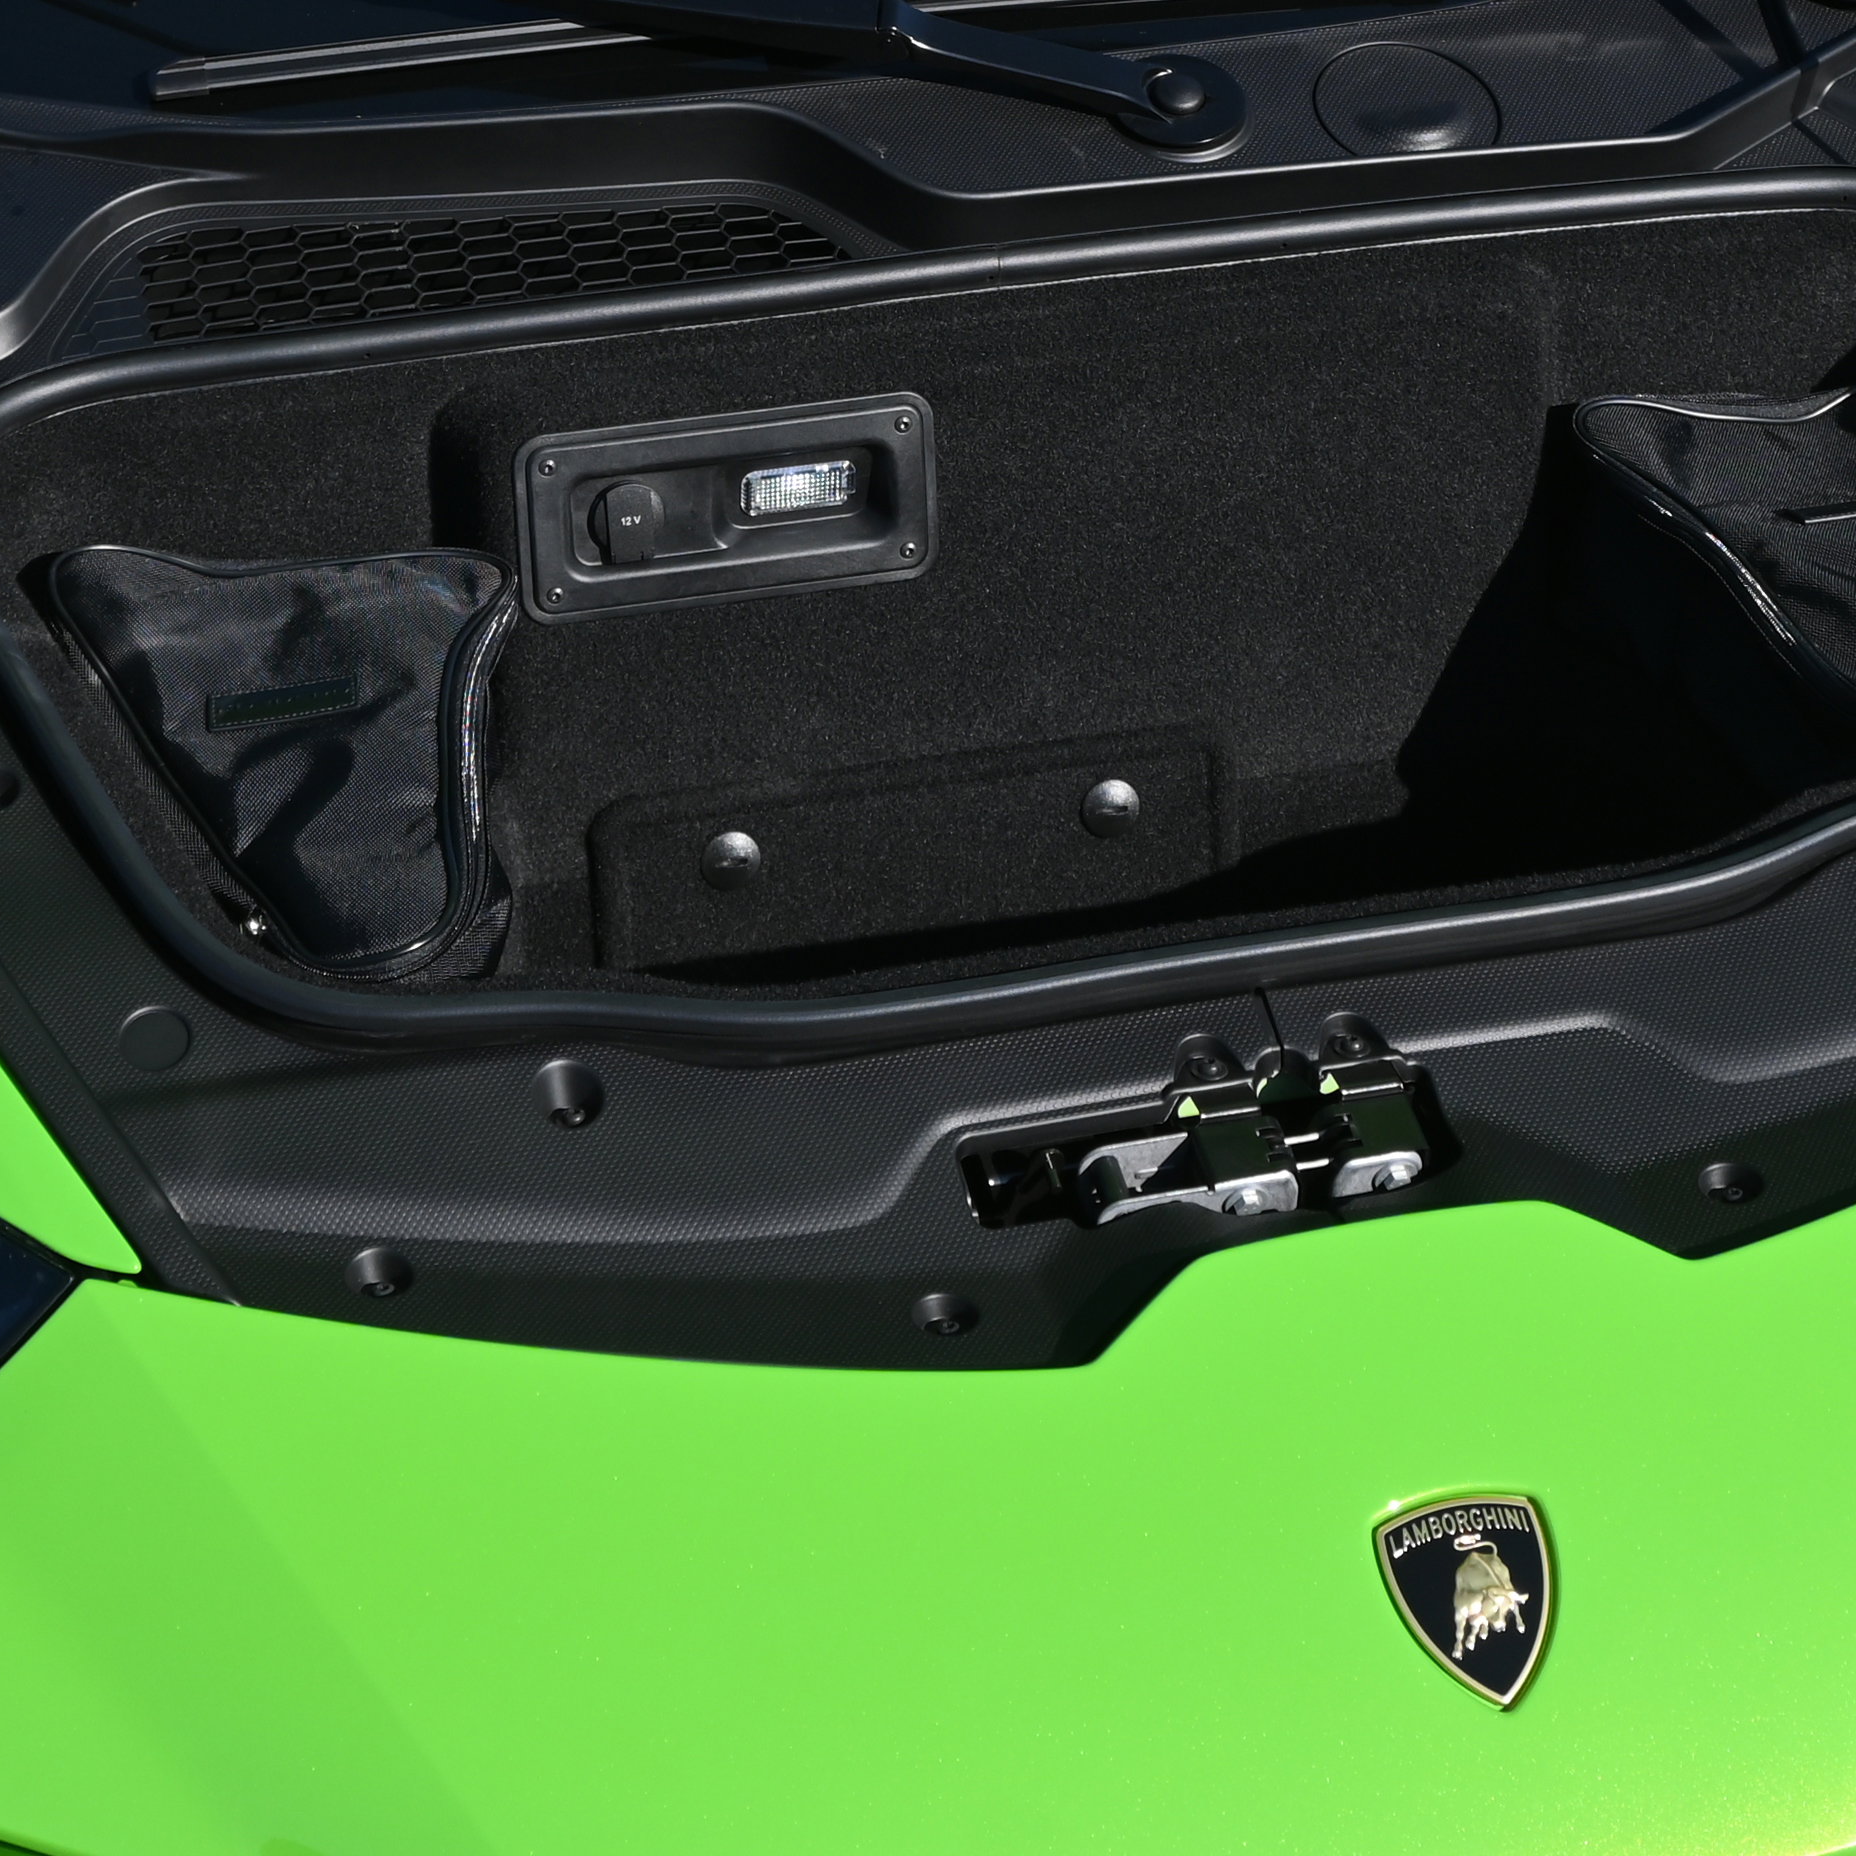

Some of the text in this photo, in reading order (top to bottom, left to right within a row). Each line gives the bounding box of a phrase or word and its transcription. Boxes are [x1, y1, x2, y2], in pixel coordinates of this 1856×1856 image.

[621, 515, 641, 526] 12 V
[1389, 1506, 1531, 1559] LAMBORGHINI
